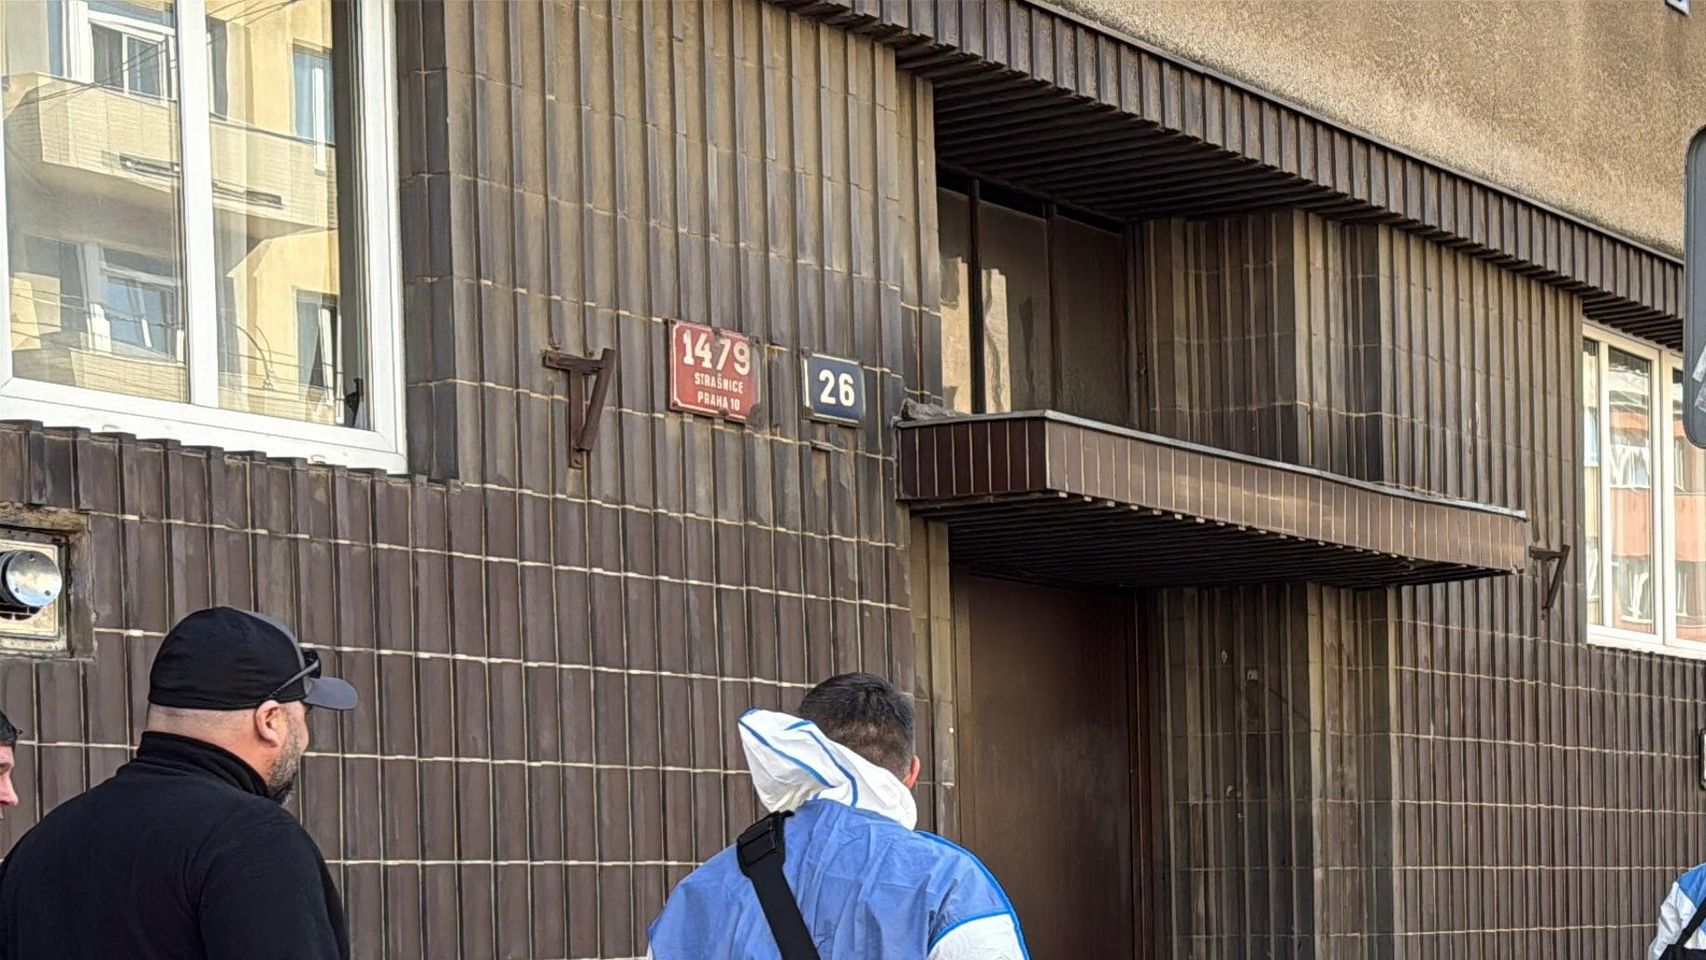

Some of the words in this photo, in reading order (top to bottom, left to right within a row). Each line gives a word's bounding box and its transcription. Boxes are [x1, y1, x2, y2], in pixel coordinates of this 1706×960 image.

[683, 329, 750, 376] 1479
[694, 372, 744, 395] STRAŠNICE
[818, 368, 855, 407] 26
[697, 390, 729, 410] PRAHA
[730, 398, 741, 411] 10
